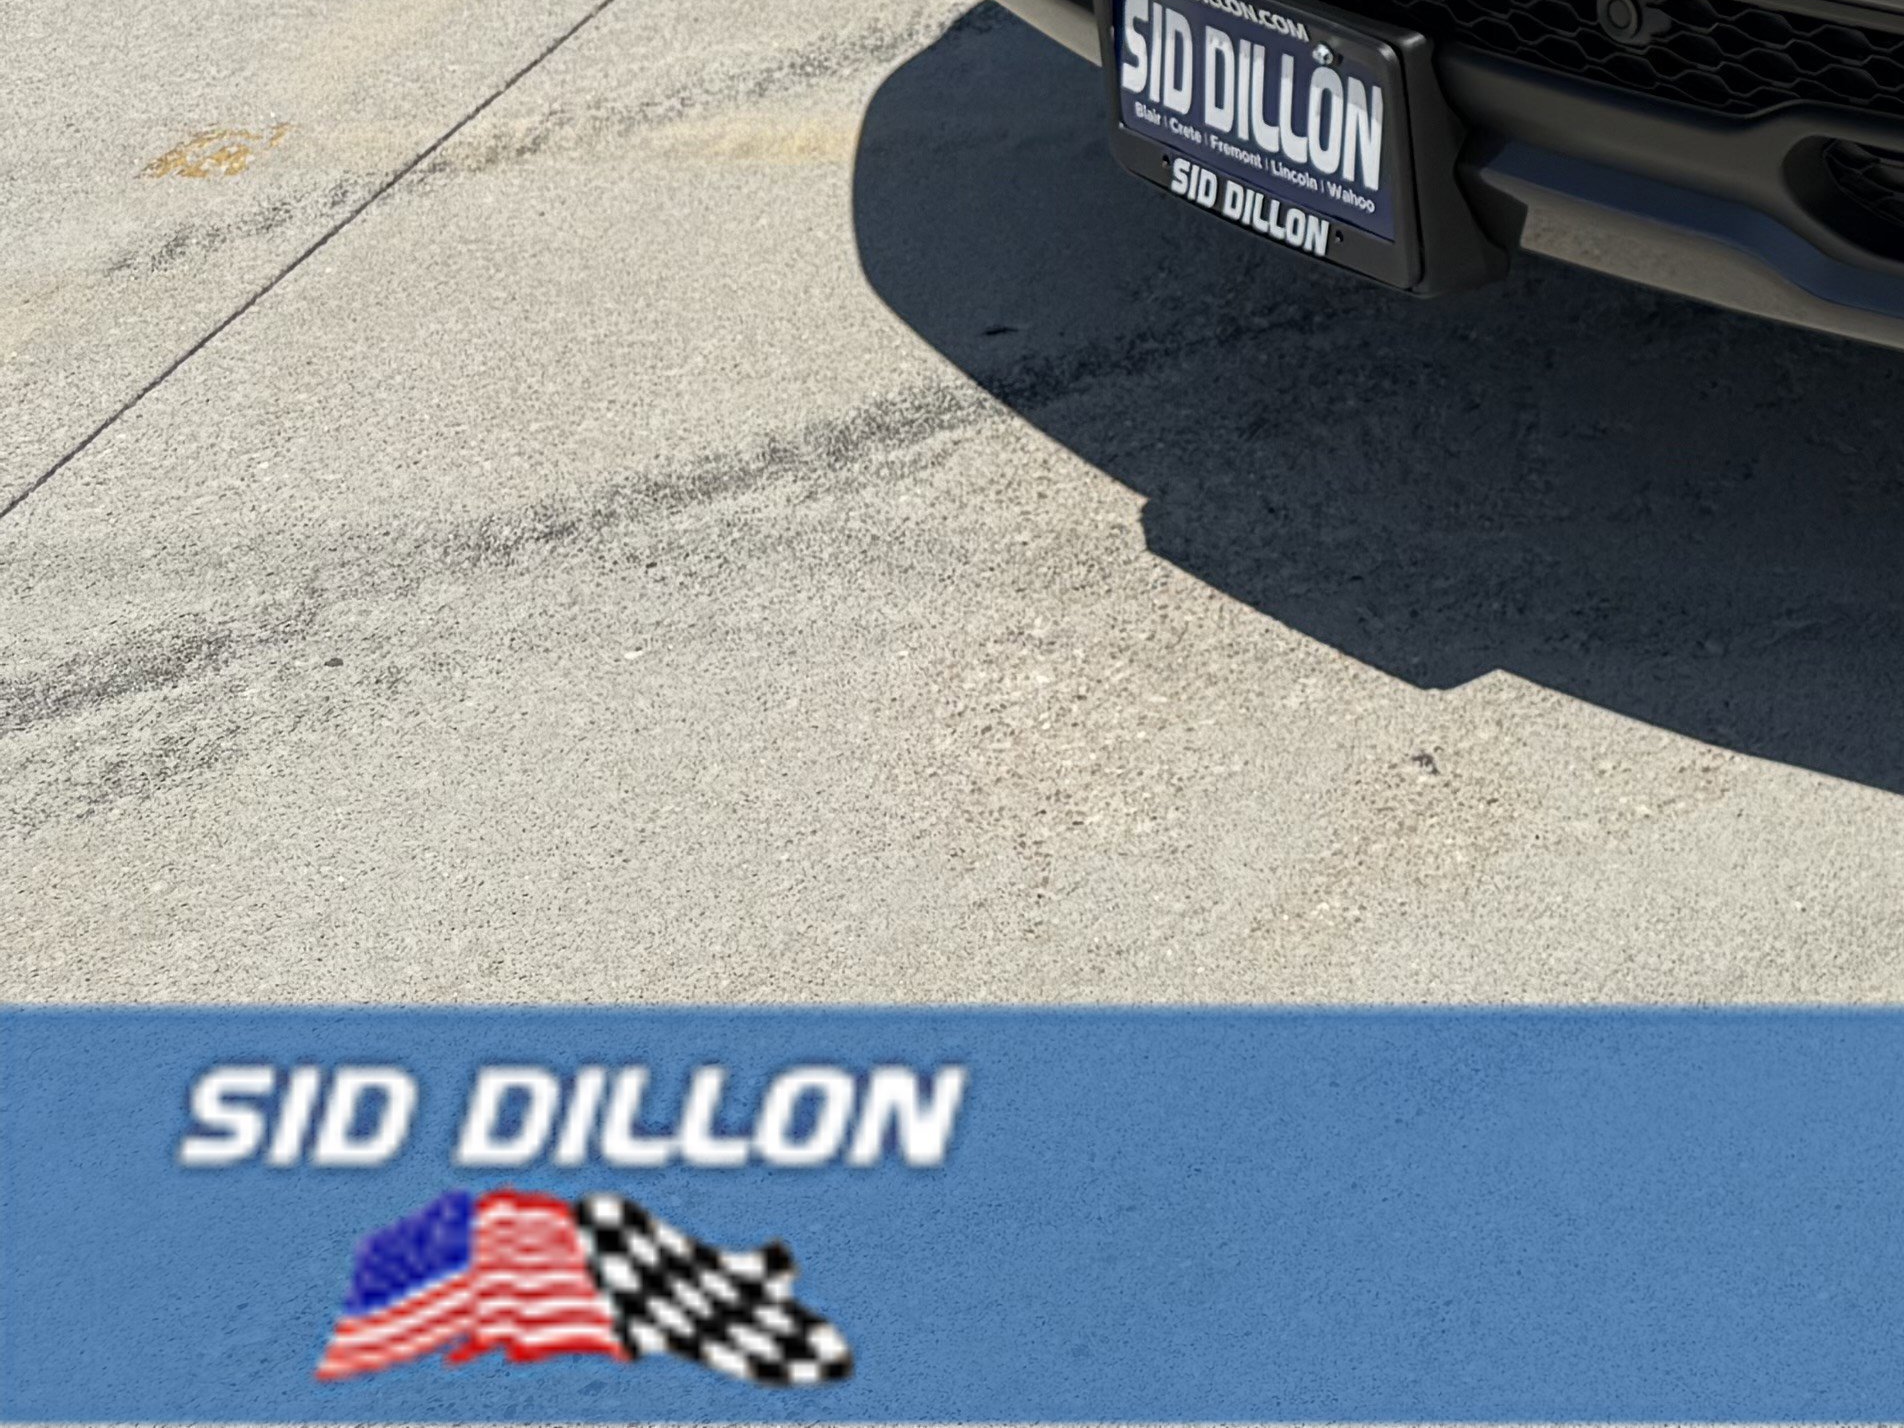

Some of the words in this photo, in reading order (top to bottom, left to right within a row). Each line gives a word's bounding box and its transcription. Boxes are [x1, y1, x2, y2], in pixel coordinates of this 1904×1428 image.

[1134, 100, 1162, 127] Blair
[1169, 117, 1203, 146] Crete
[1209, 133, 1264, 171] Fremont
[1270, 158, 1319, 192] Lincoln
[1327, 180, 1377, 215] Wahoo
[1203, 25, 1385, 192] DILLON
[1170, 157, 1218, 211] SID
[1224, 184, 1331, 258] DILLON
